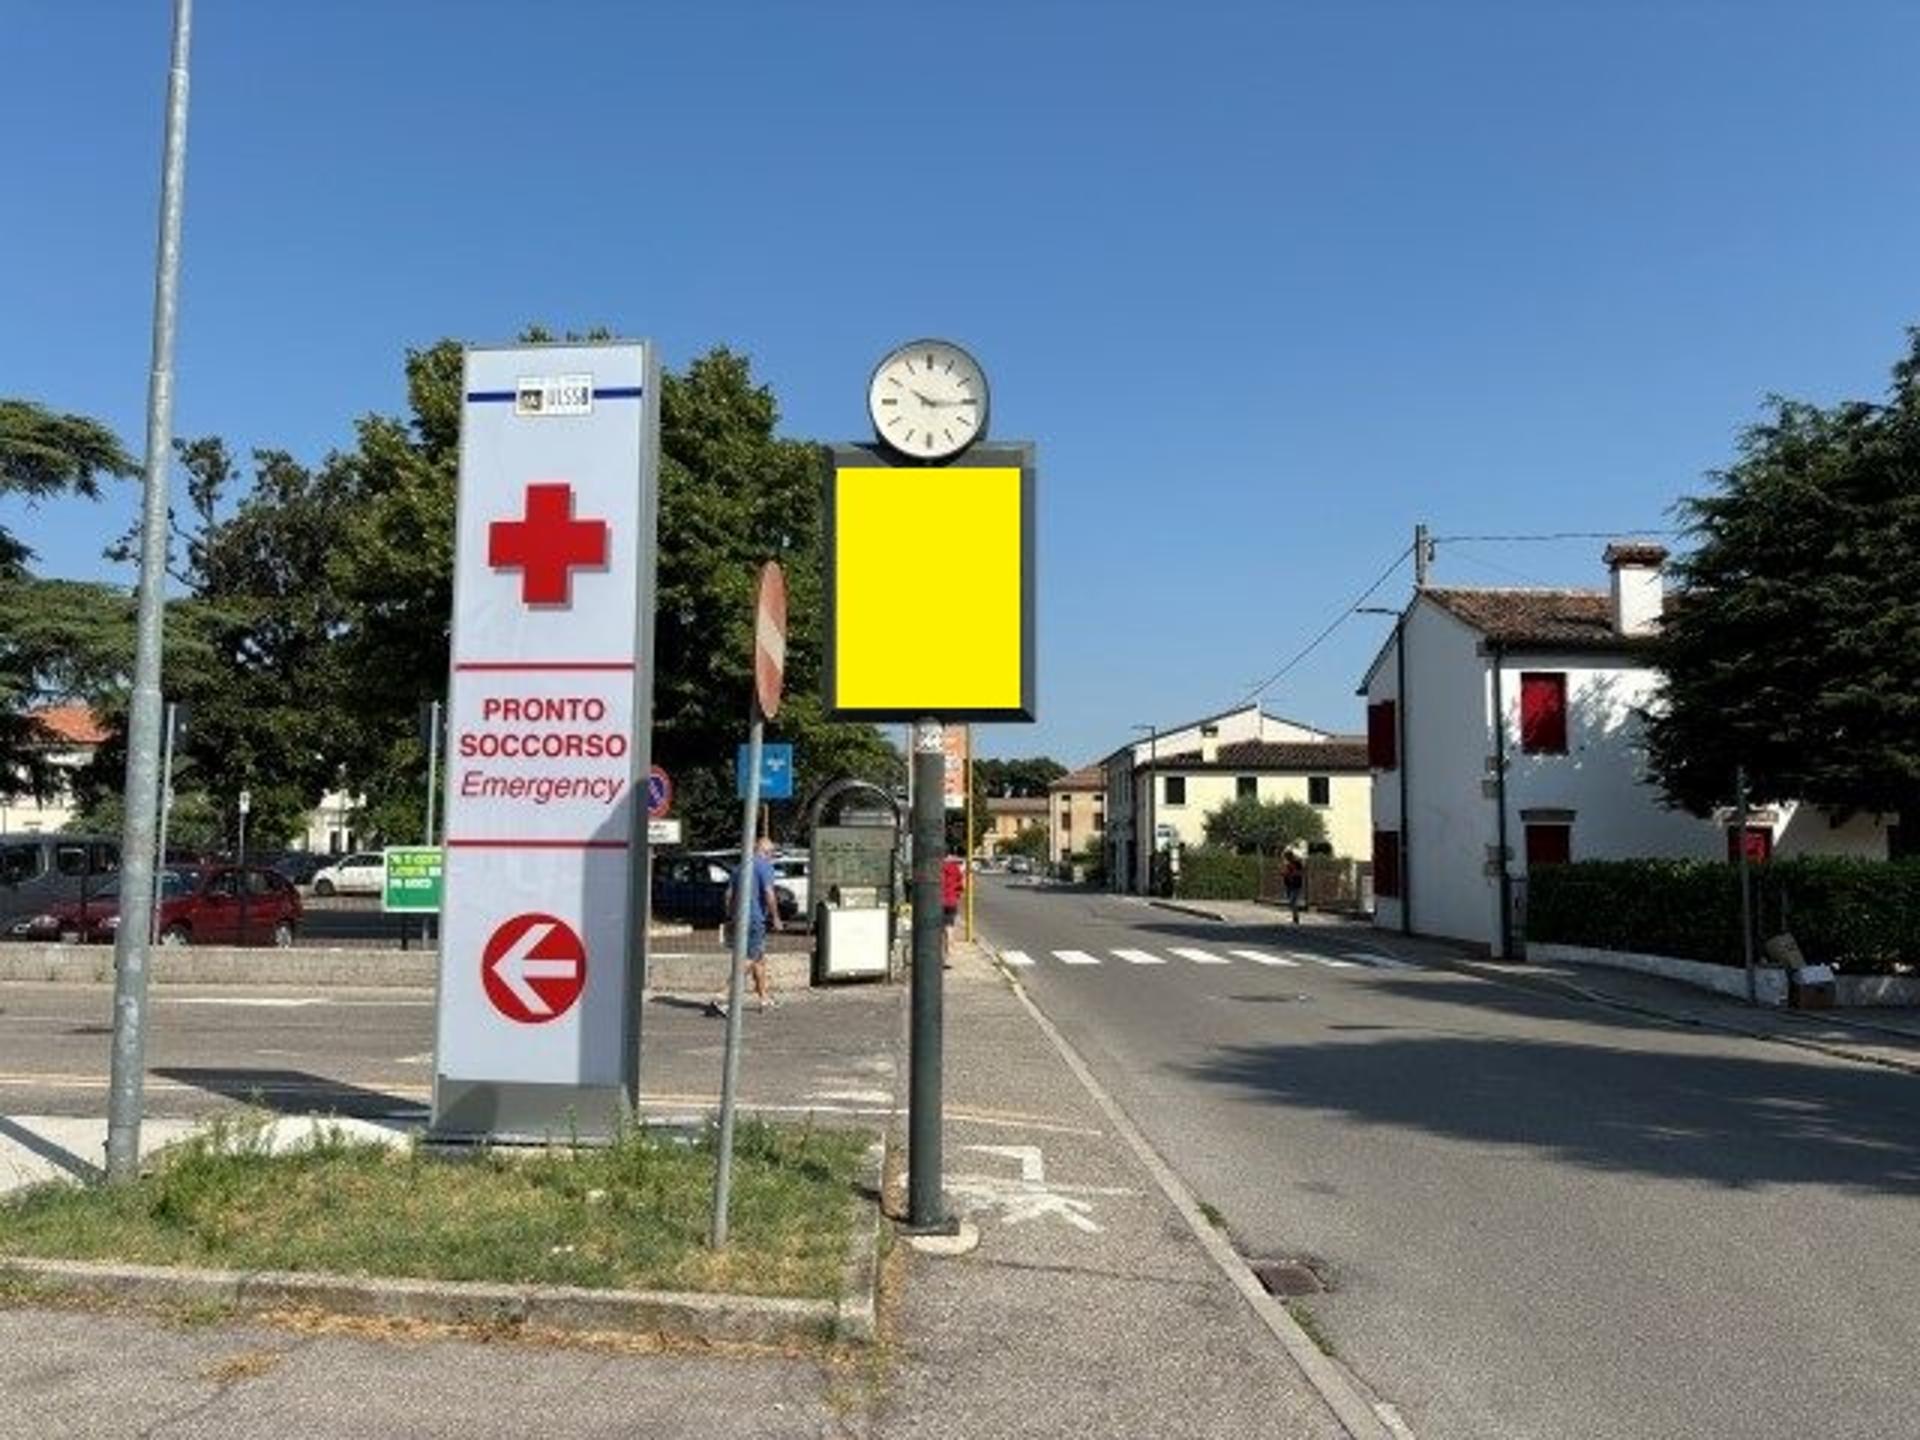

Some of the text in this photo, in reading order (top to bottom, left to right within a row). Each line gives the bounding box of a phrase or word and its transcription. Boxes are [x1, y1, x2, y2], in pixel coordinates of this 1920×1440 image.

[483, 698, 605, 721] PRONTO
[460, 734, 627, 757] SOCCORSO
[461, 770, 625, 804] Emergency
